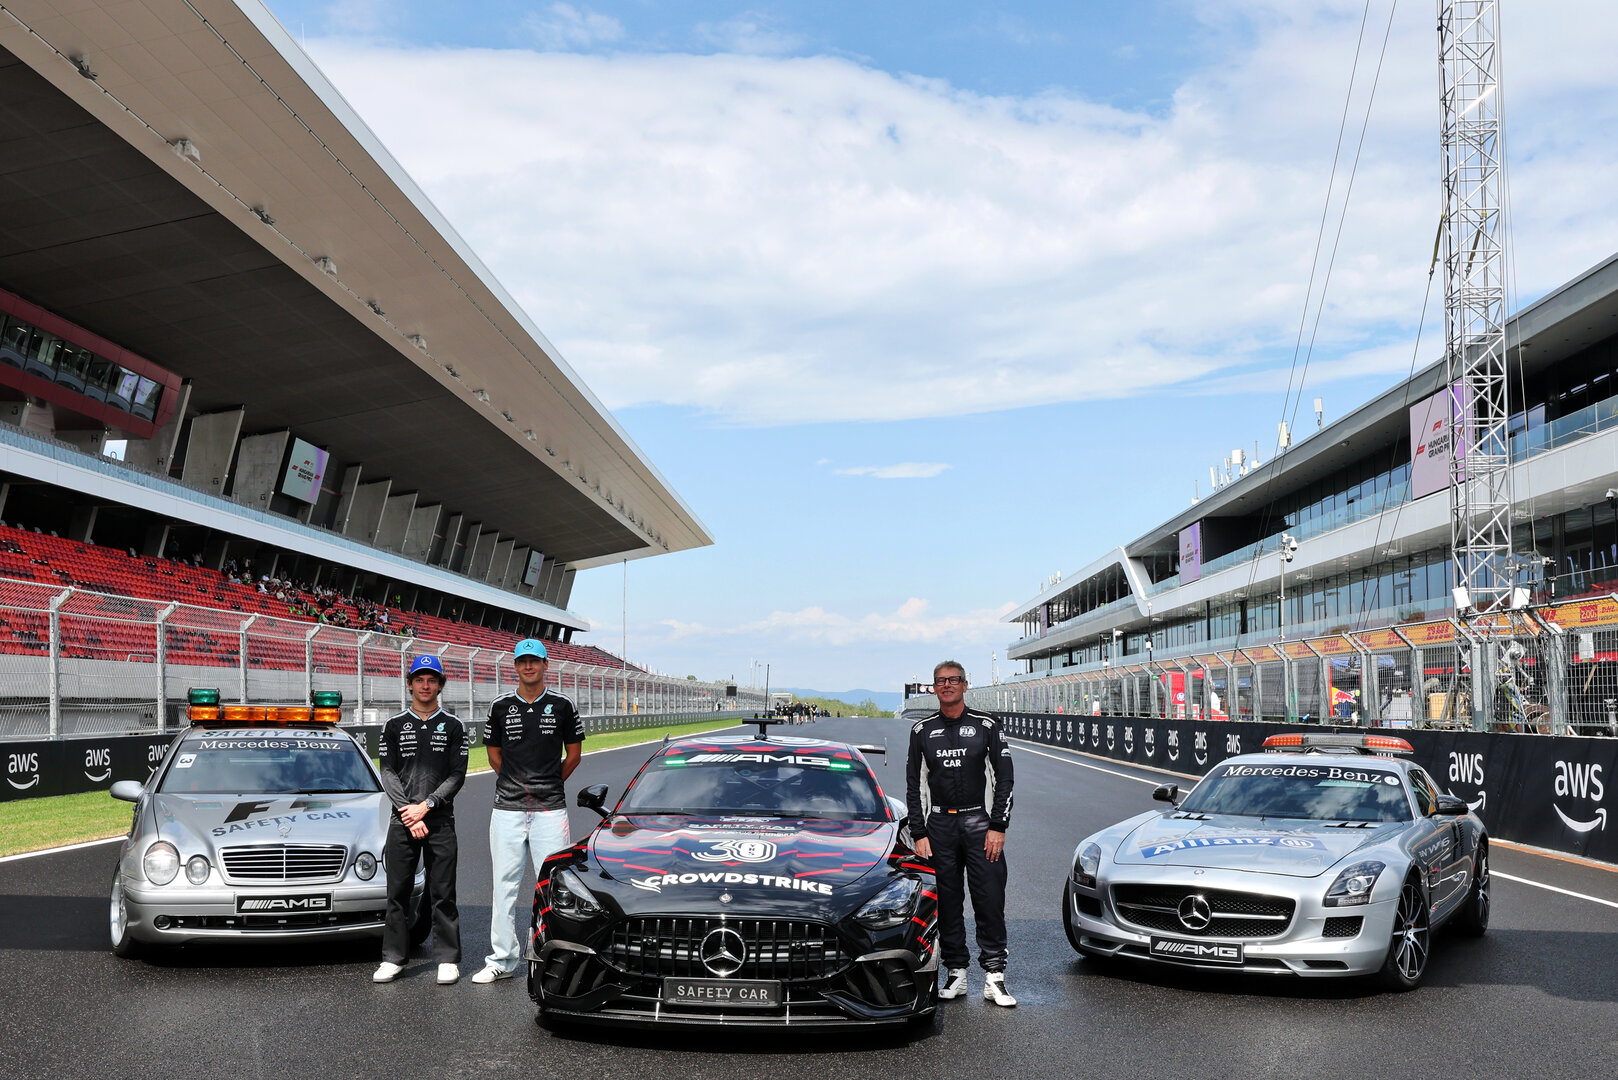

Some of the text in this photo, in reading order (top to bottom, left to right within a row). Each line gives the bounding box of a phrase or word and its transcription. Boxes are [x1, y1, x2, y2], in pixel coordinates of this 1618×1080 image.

[198, 739, 341, 750] Mercedes-Benz
[936, 748, 967, 757] SAFETY
[1226, 733, 1240, 754] aws
[8, 752, 38, 774] aws
[85, 748, 110, 767] aws
[731, 754, 831, 766] AMG
[943, 759, 961, 767] CAR
[1222, 765, 1382, 783] Mercedes-Benz
[1449, 751, 1484, 786] aws
[1554, 760, 1604, 801] aws
[212, 811, 351, 837] SAFETY CAR
[691, 839, 777, 863] 30
[1153, 836, 1274, 855] Allianz
[644, 872, 833, 896] CROWDSTRIKE
[267, 897, 326, 909] AMG
[1180, 943, 1238, 958] AMG
[677, 985, 768, 999] SAFETY CAR
